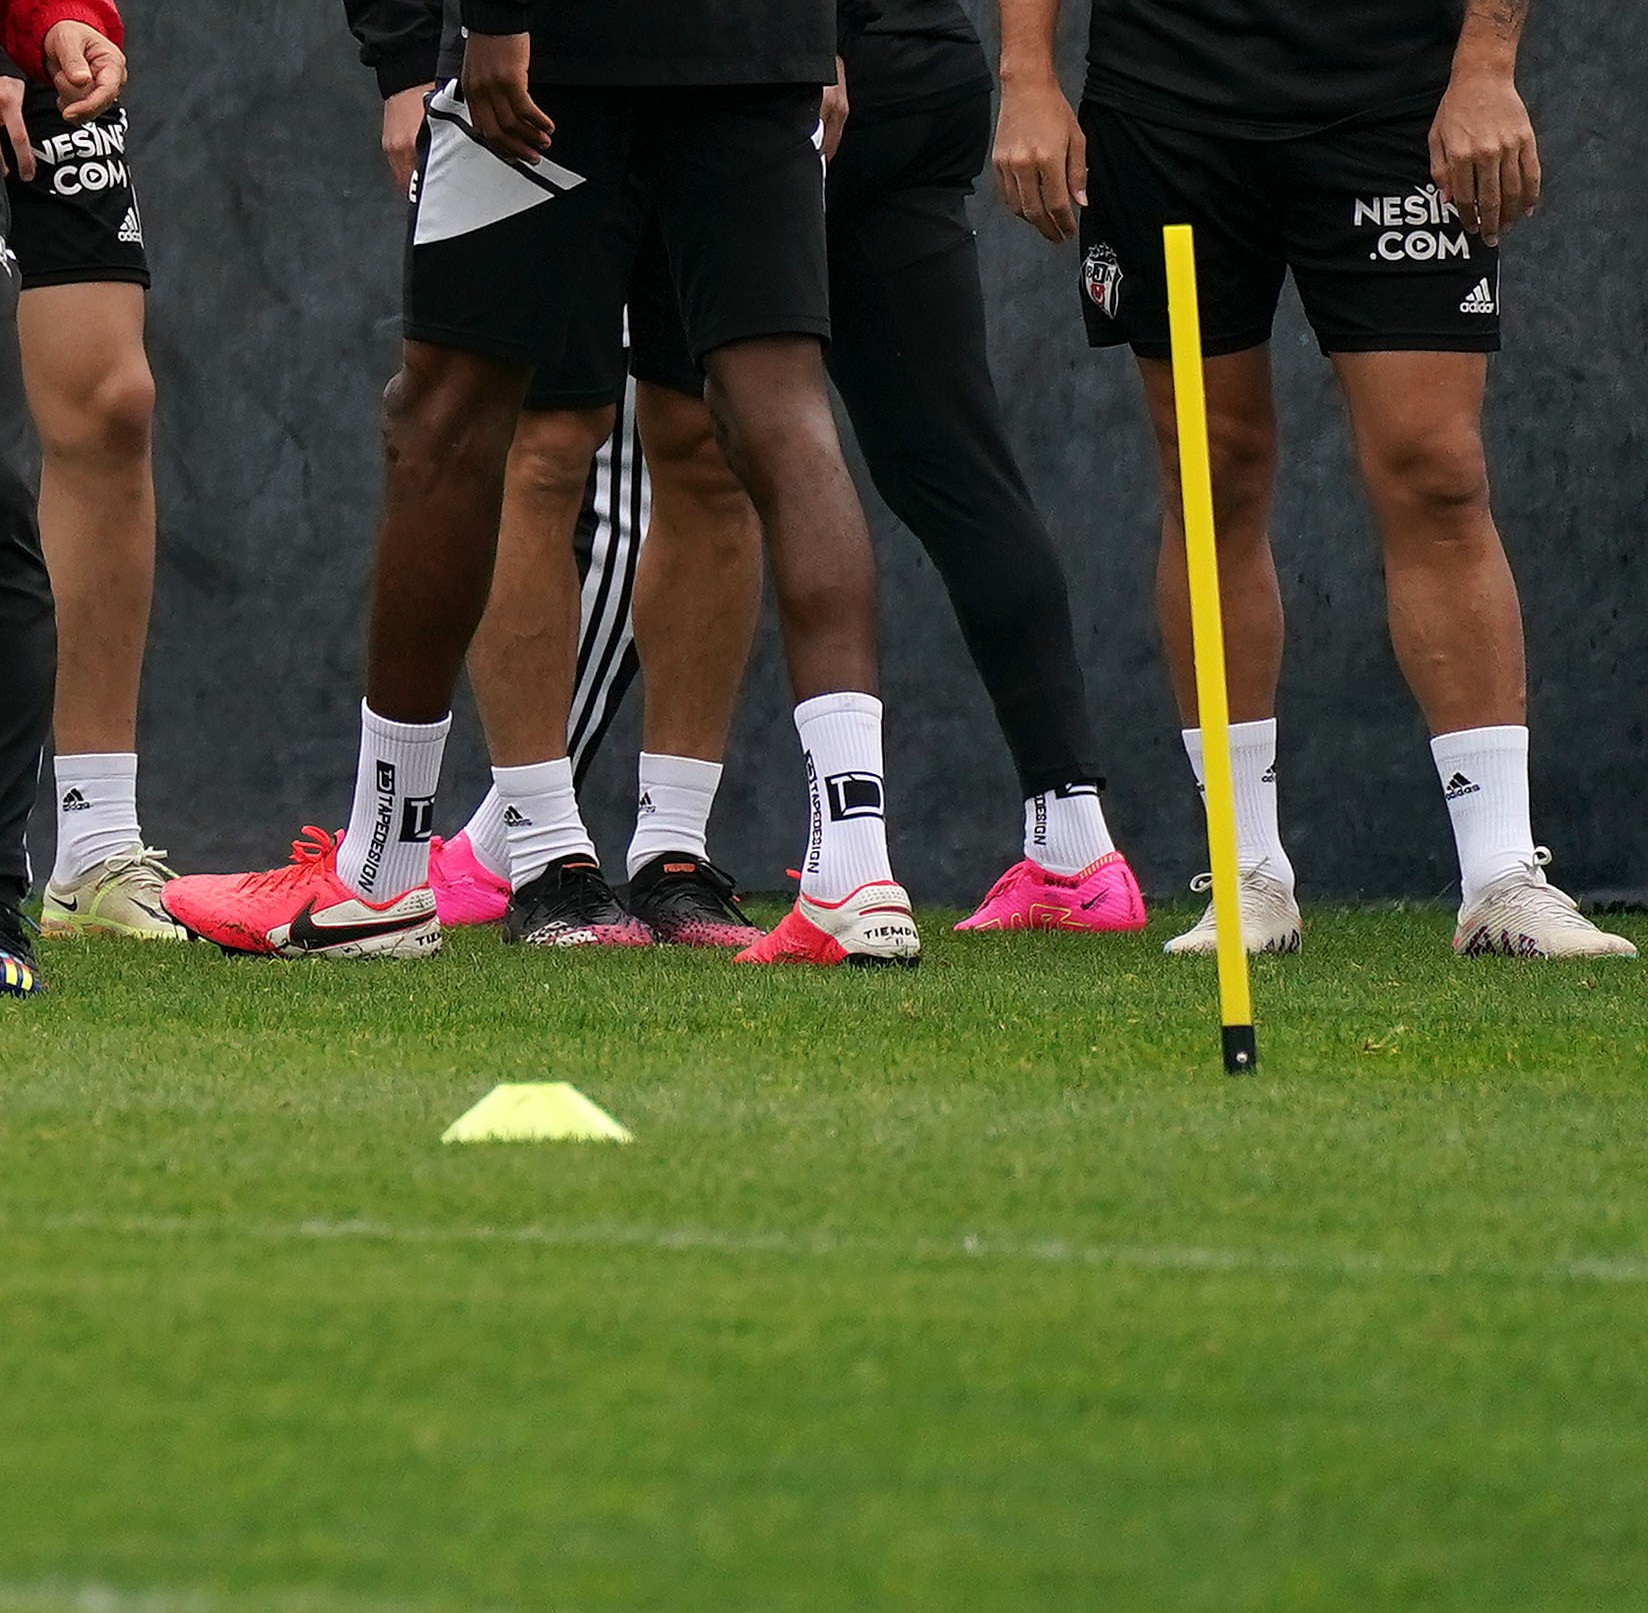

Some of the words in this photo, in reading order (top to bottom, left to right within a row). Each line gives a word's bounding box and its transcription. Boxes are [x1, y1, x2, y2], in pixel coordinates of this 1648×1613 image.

[1354, 183, 1461, 227] NESI
[1369, 230, 1471, 261] .COM
[1459, 302, 1495, 314] adida
[357, 794, 394, 894] TAPEDESIGN
